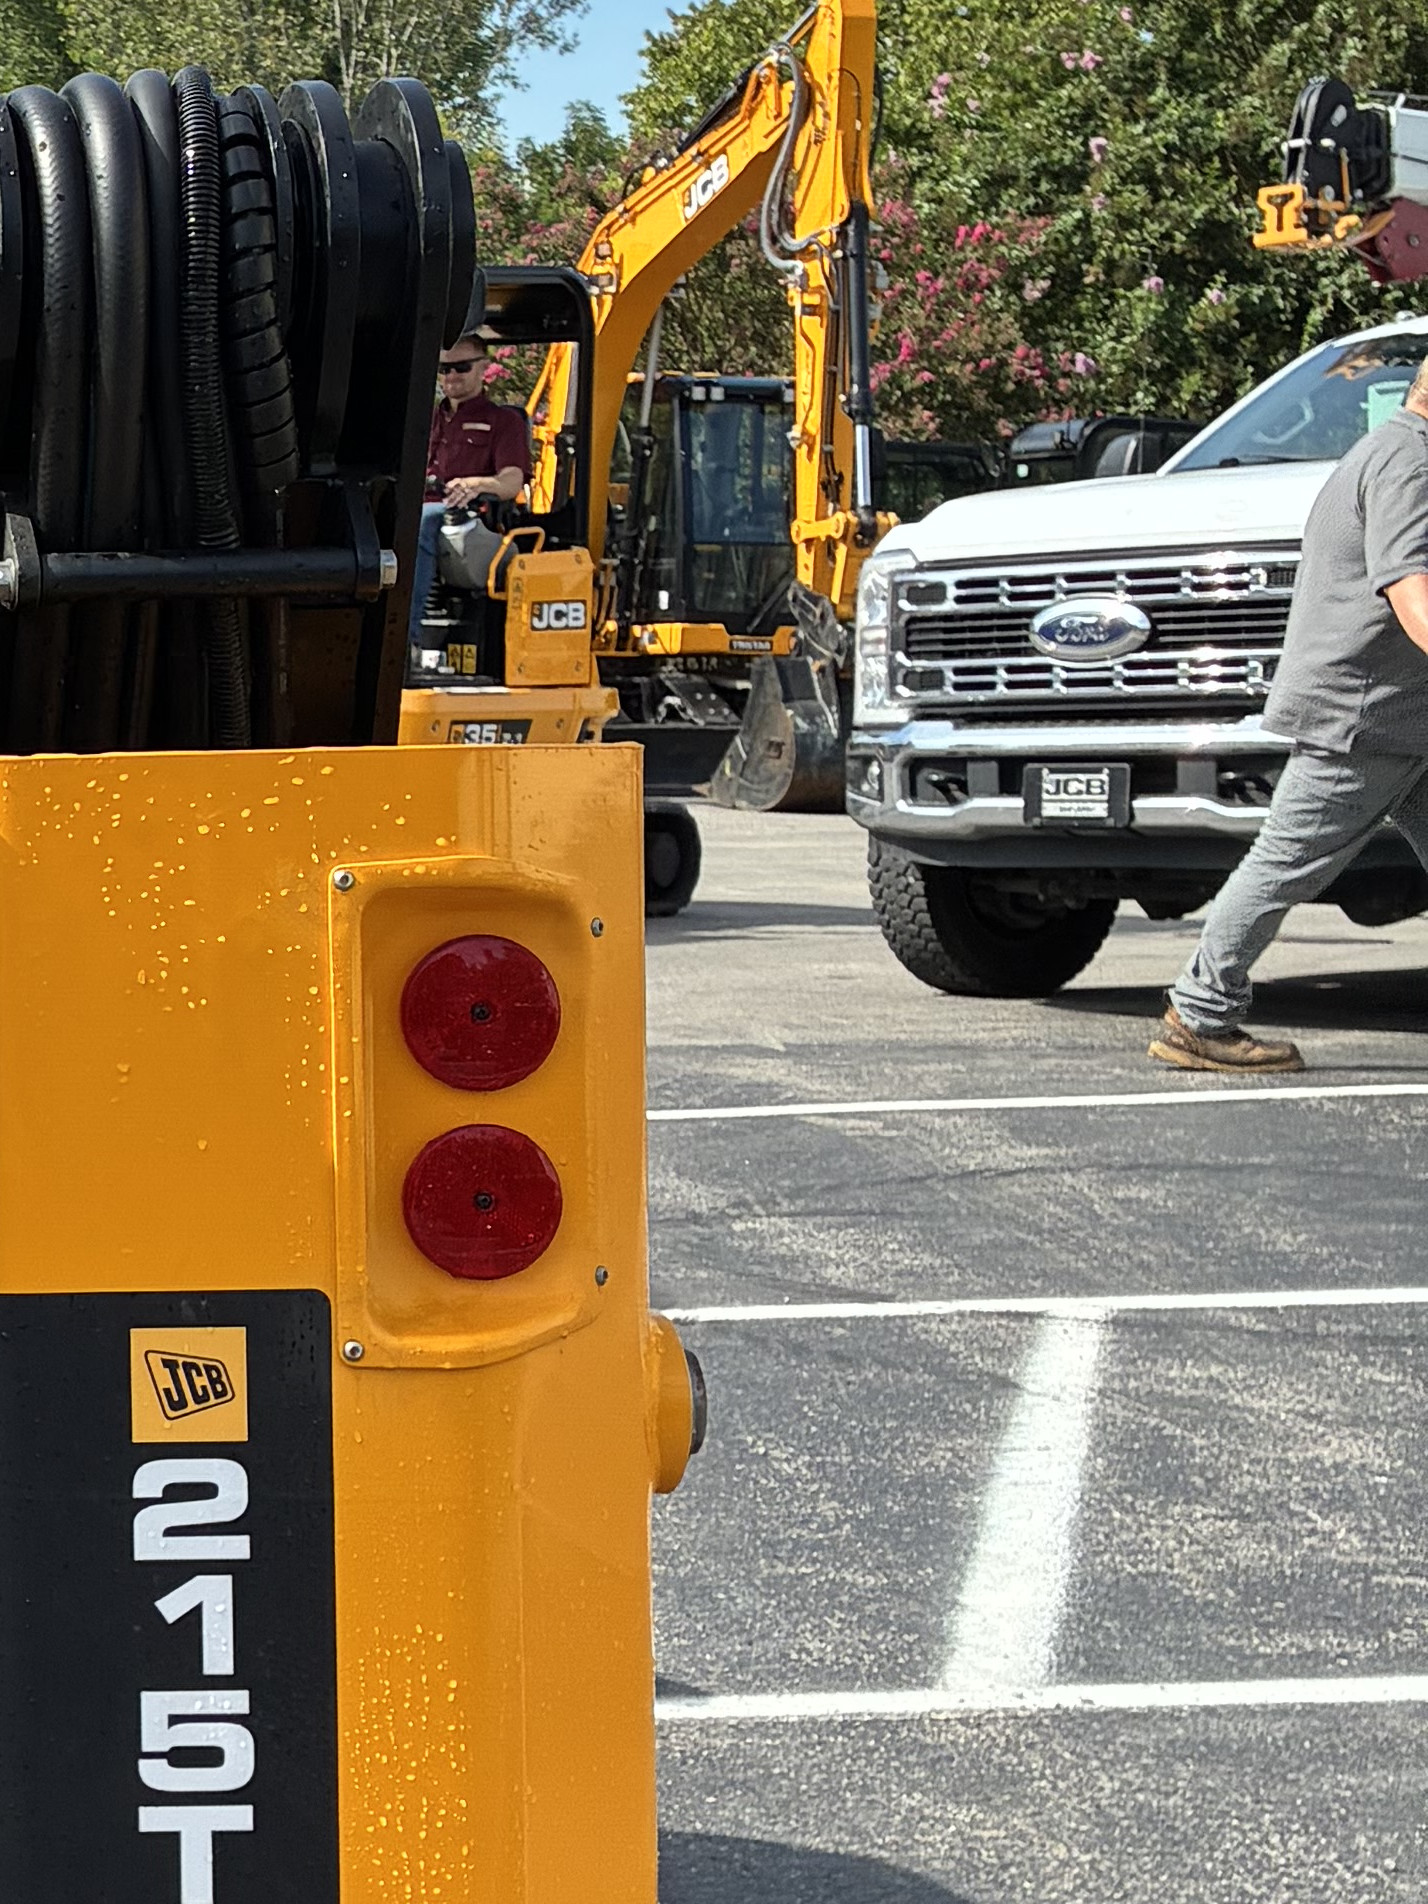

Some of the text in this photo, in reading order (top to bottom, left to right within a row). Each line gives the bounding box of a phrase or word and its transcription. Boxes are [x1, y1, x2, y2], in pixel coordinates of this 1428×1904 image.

[684, 154, 729, 219] JCB
[532, 601, 586, 628] JCB
[464, 724, 498, 744] 35
[1044, 777, 1107, 796] JCB
[160, 1357, 230, 1415] JCB
